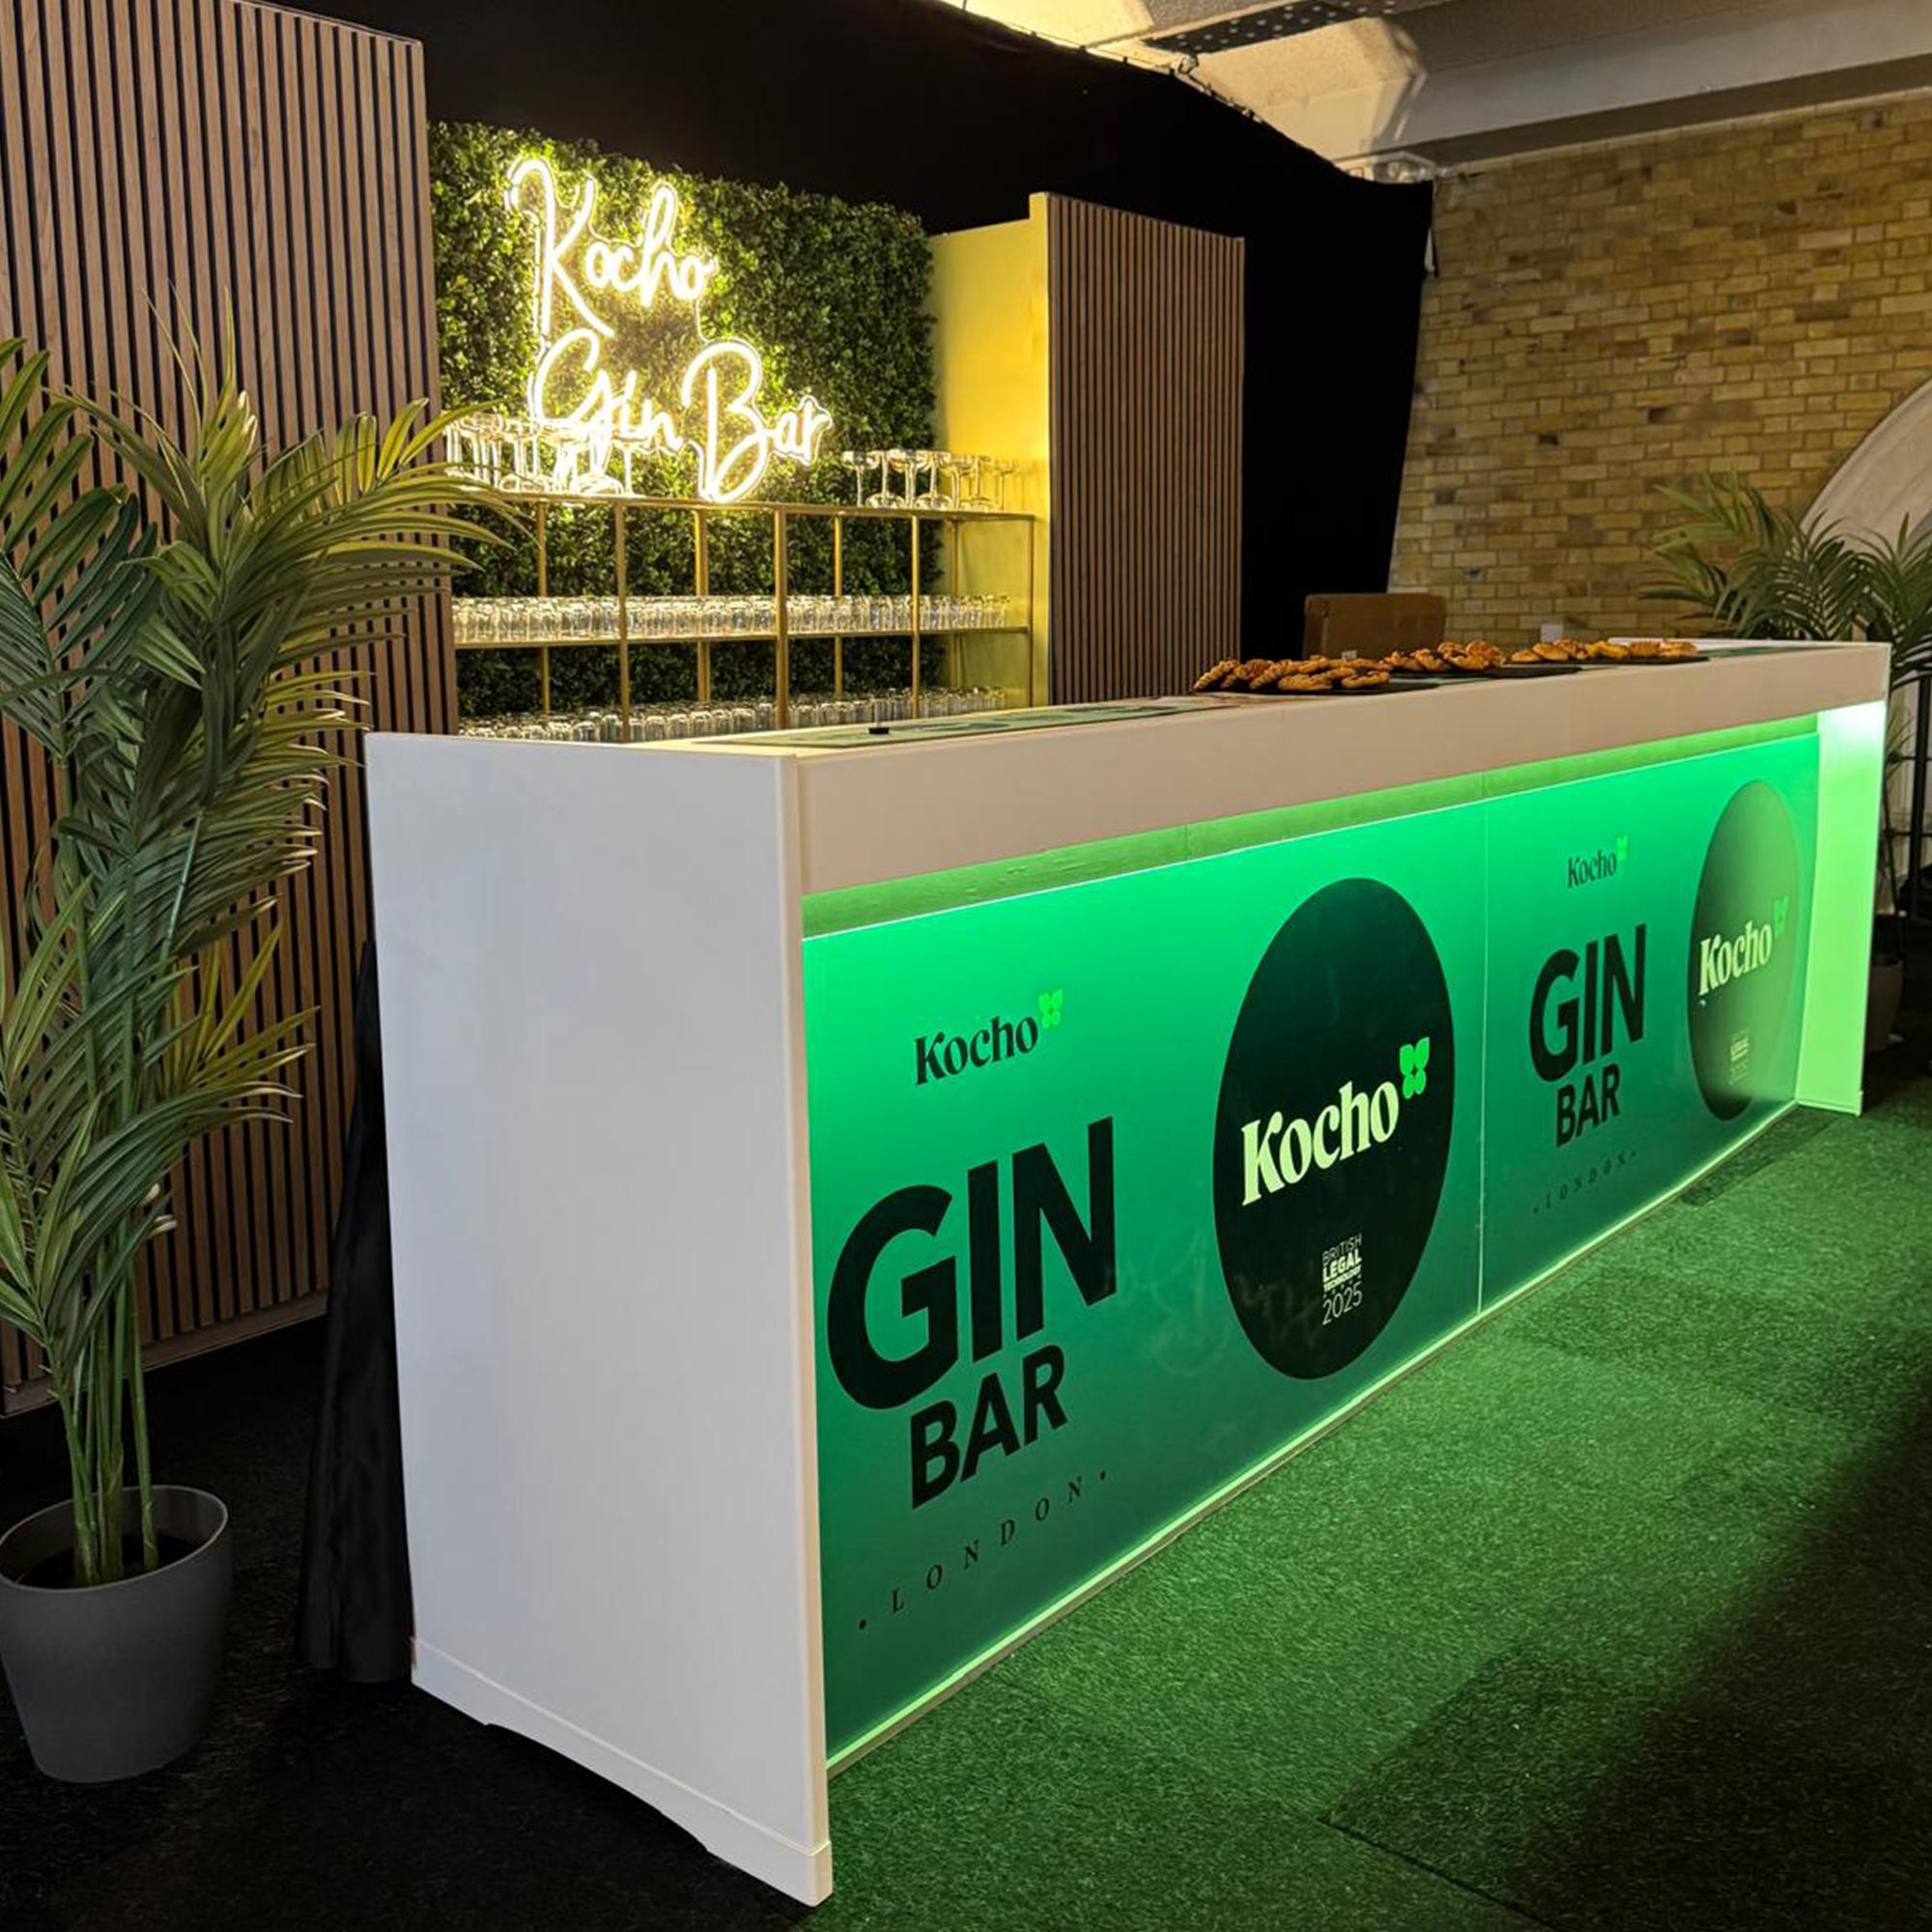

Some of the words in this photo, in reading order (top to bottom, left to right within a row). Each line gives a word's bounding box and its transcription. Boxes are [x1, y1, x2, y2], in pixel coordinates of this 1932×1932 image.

[506, 157, 716, 340] Kocho
[533, 327, 682, 477] Gin
[679, 342, 832, 504] Bar
[1567, 850, 1617, 888] Kocho
[1529, 923, 1646, 1082] GIN
[1698, 920, 1773, 996] Kocho
[914, 1014, 1039, 1086] Kocho
[1241, 1080, 1399, 1206] Kocho
[1556, 1063, 1621, 1149] BAR
[827, 1115, 1117, 1409] GIN
[1321, 1280, 1363, 1325] 2025
[1322, 1248, 1363, 1284] LEGAL
[910, 1345, 1068, 1510] BAR
